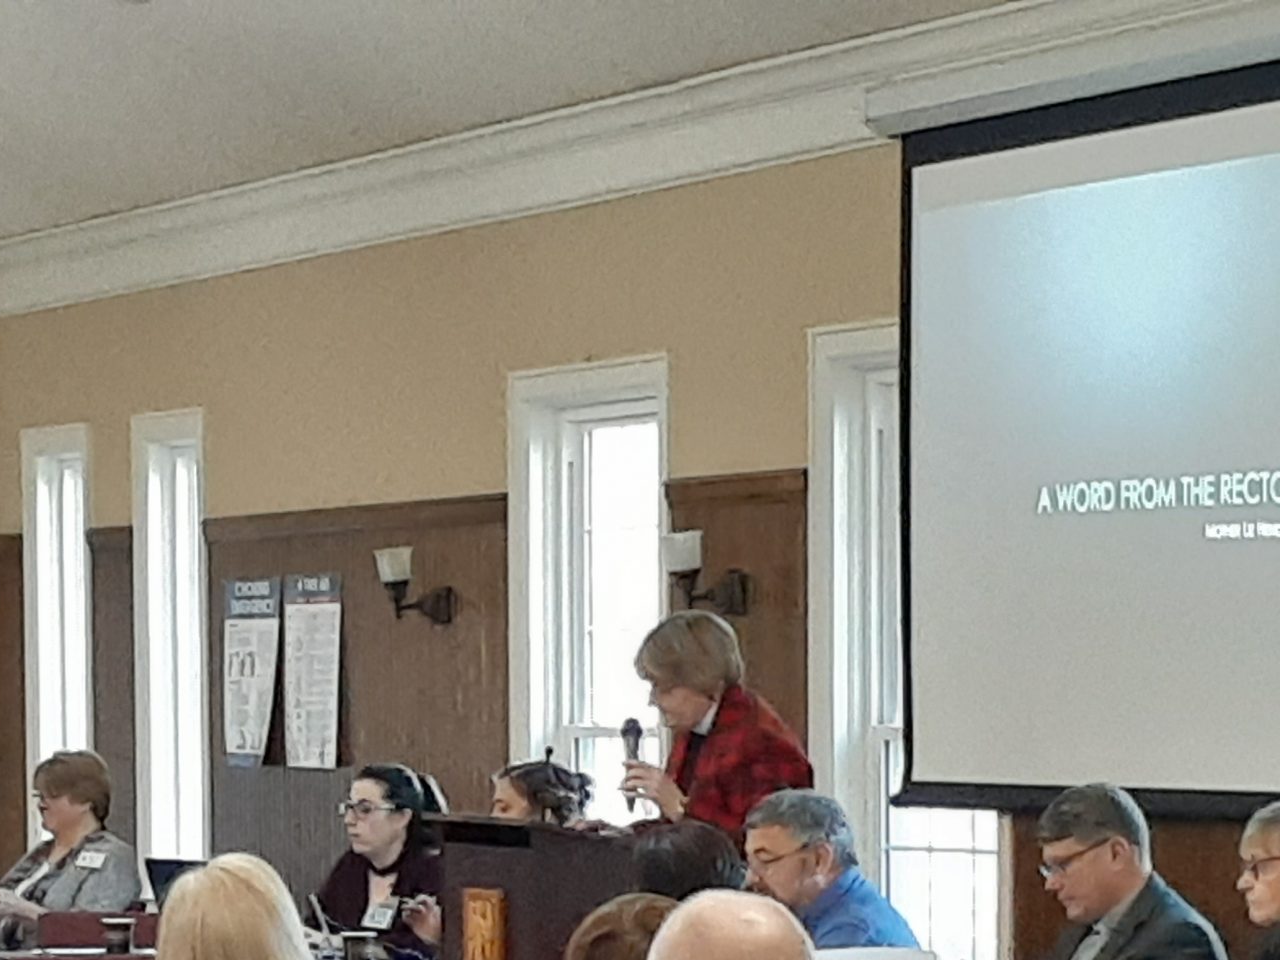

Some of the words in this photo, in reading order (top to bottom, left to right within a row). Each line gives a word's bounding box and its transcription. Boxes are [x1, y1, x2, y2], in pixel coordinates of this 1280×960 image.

[1037, 486, 1053, 514] A
[1056, 481, 1115, 513] WORD
[1120, 477, 1176, 510] FROM
[1180, 475, 1215, 506] THE
